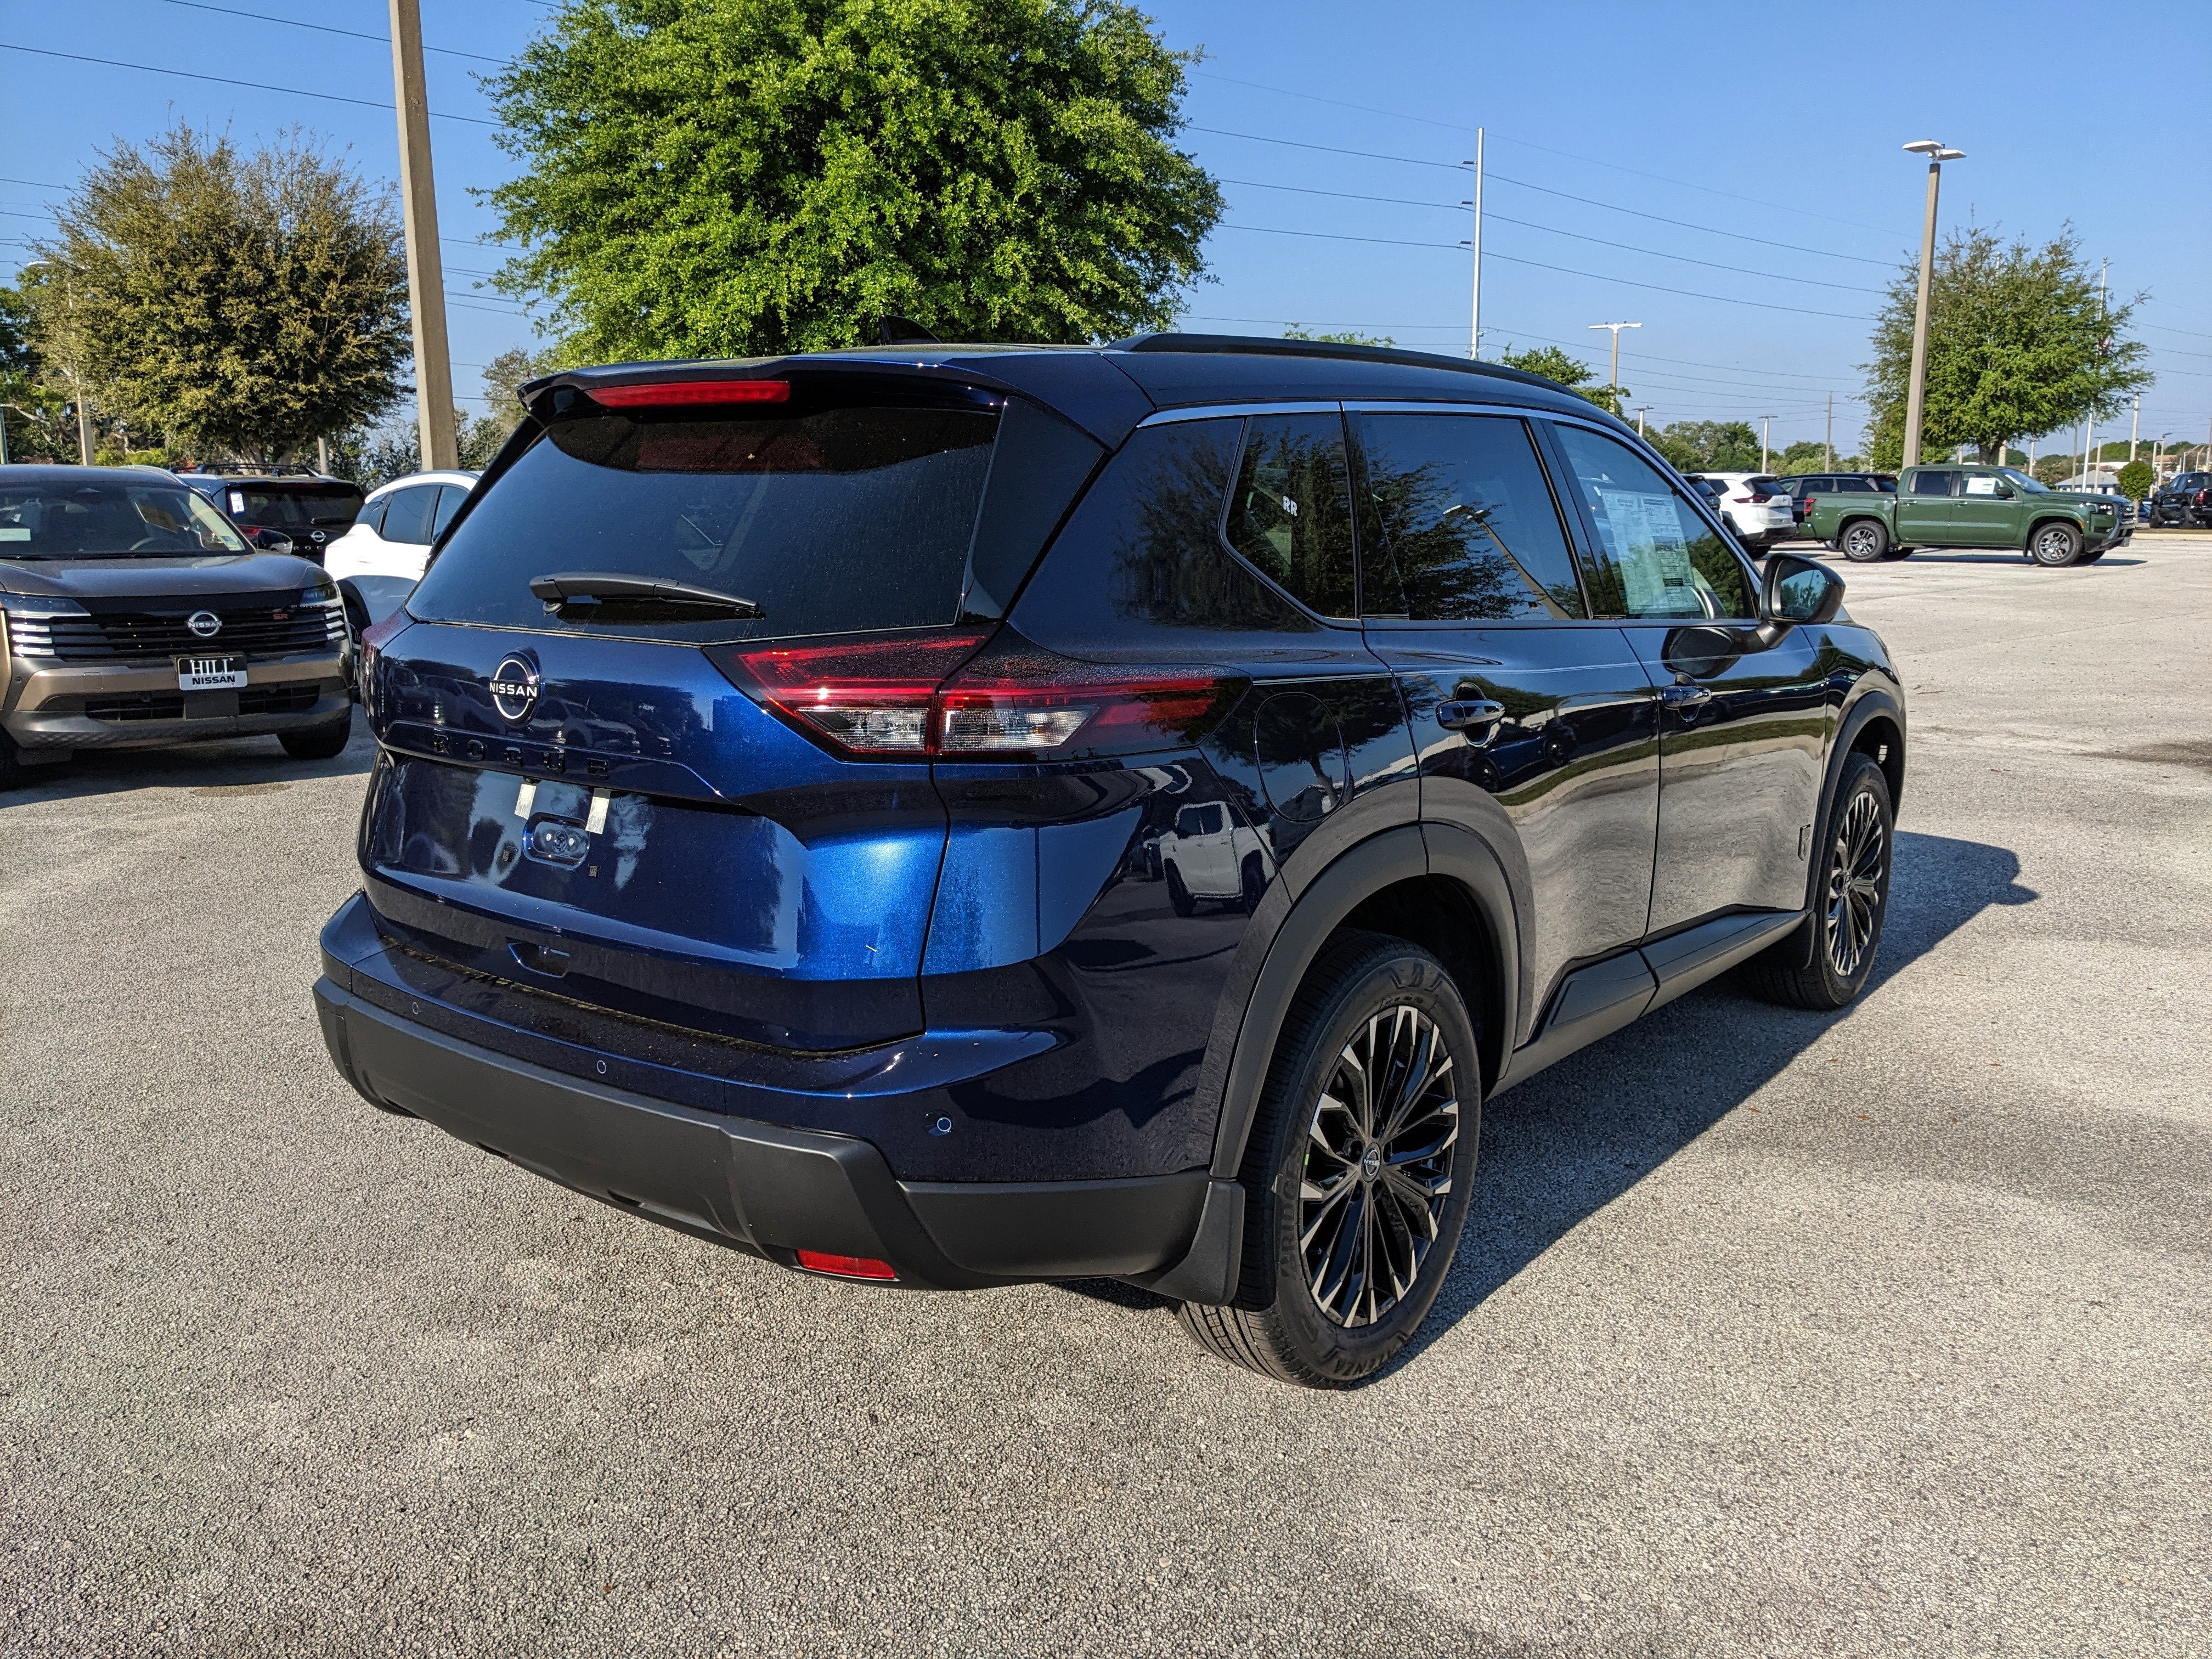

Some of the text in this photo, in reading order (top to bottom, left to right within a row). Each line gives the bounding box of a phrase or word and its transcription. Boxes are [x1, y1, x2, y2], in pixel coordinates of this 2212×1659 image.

[1283, 495, 1297, 516] RR
[191, 659, 235, 676] HILL
[192, 676, 235, 685] NISSAN
[489, 682, 537, 697] NISSAN
